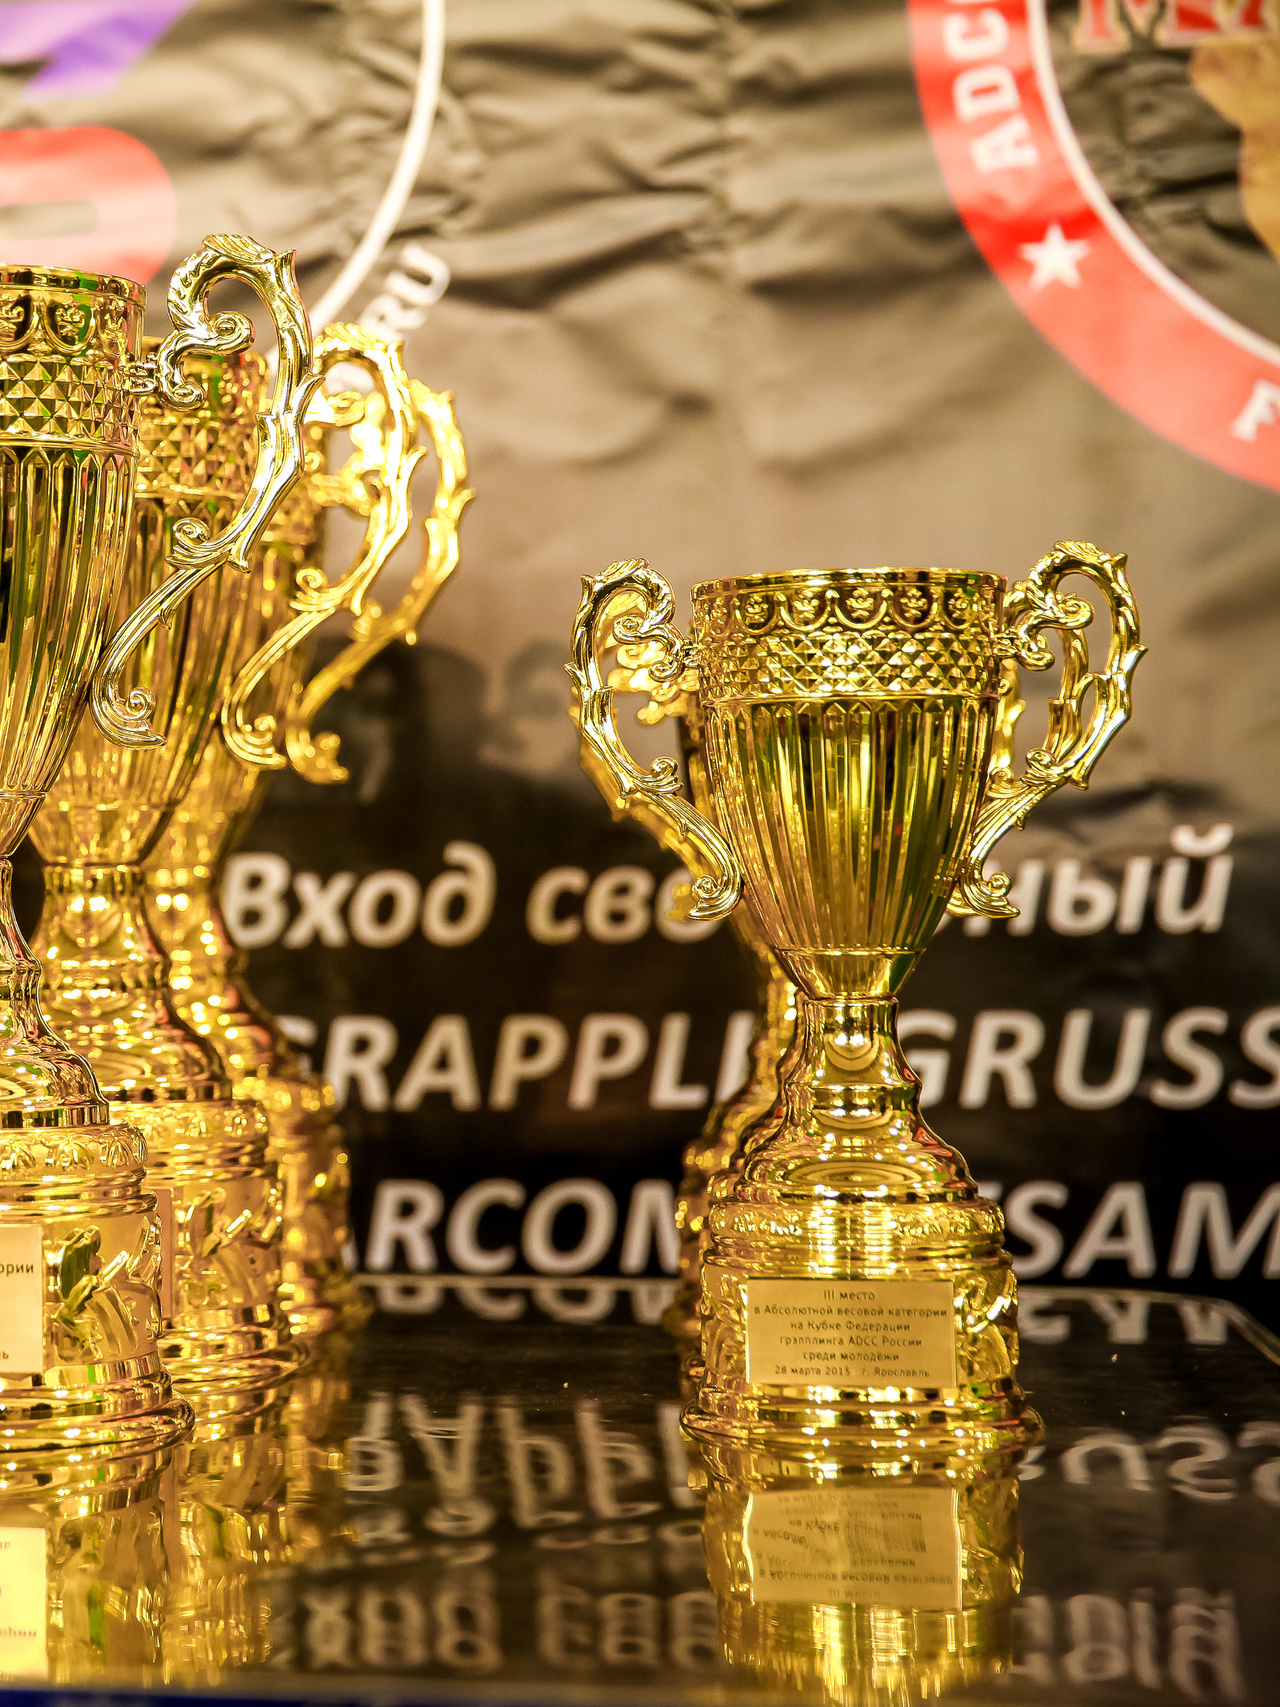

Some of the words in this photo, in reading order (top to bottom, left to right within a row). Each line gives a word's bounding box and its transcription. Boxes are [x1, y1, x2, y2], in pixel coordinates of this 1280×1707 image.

[223, 841, 497, 949] Вход
[824, 1289, 835, 1300] III
[839, 1291, 875, 1301] место
[754, 1306, 760, 1315] в
[764, 1305, 833, 1316] Абсолютной
[837, 1305, 884, 1316] весовой
[888, 1308, 947, 1318] категории
[791, 1322, 803, 1330] на
[807, 1321, 842, 1333] Кубке
[845, 1321, 911, 1333] Федерации
[779, 1336, 844, 1346] грэпплинга
[848, 1336, 878, 1346] ADCC
[882, 1336, 923, 1347] России
[803, 1352, 836, 1363] среди
[775, 1365, 787, 1375] 28
[791, 1367, 821, 1377] марта
[825, 1366, 851, 1376] 2015
[874, 1367, 930, 1378] Ярославль
